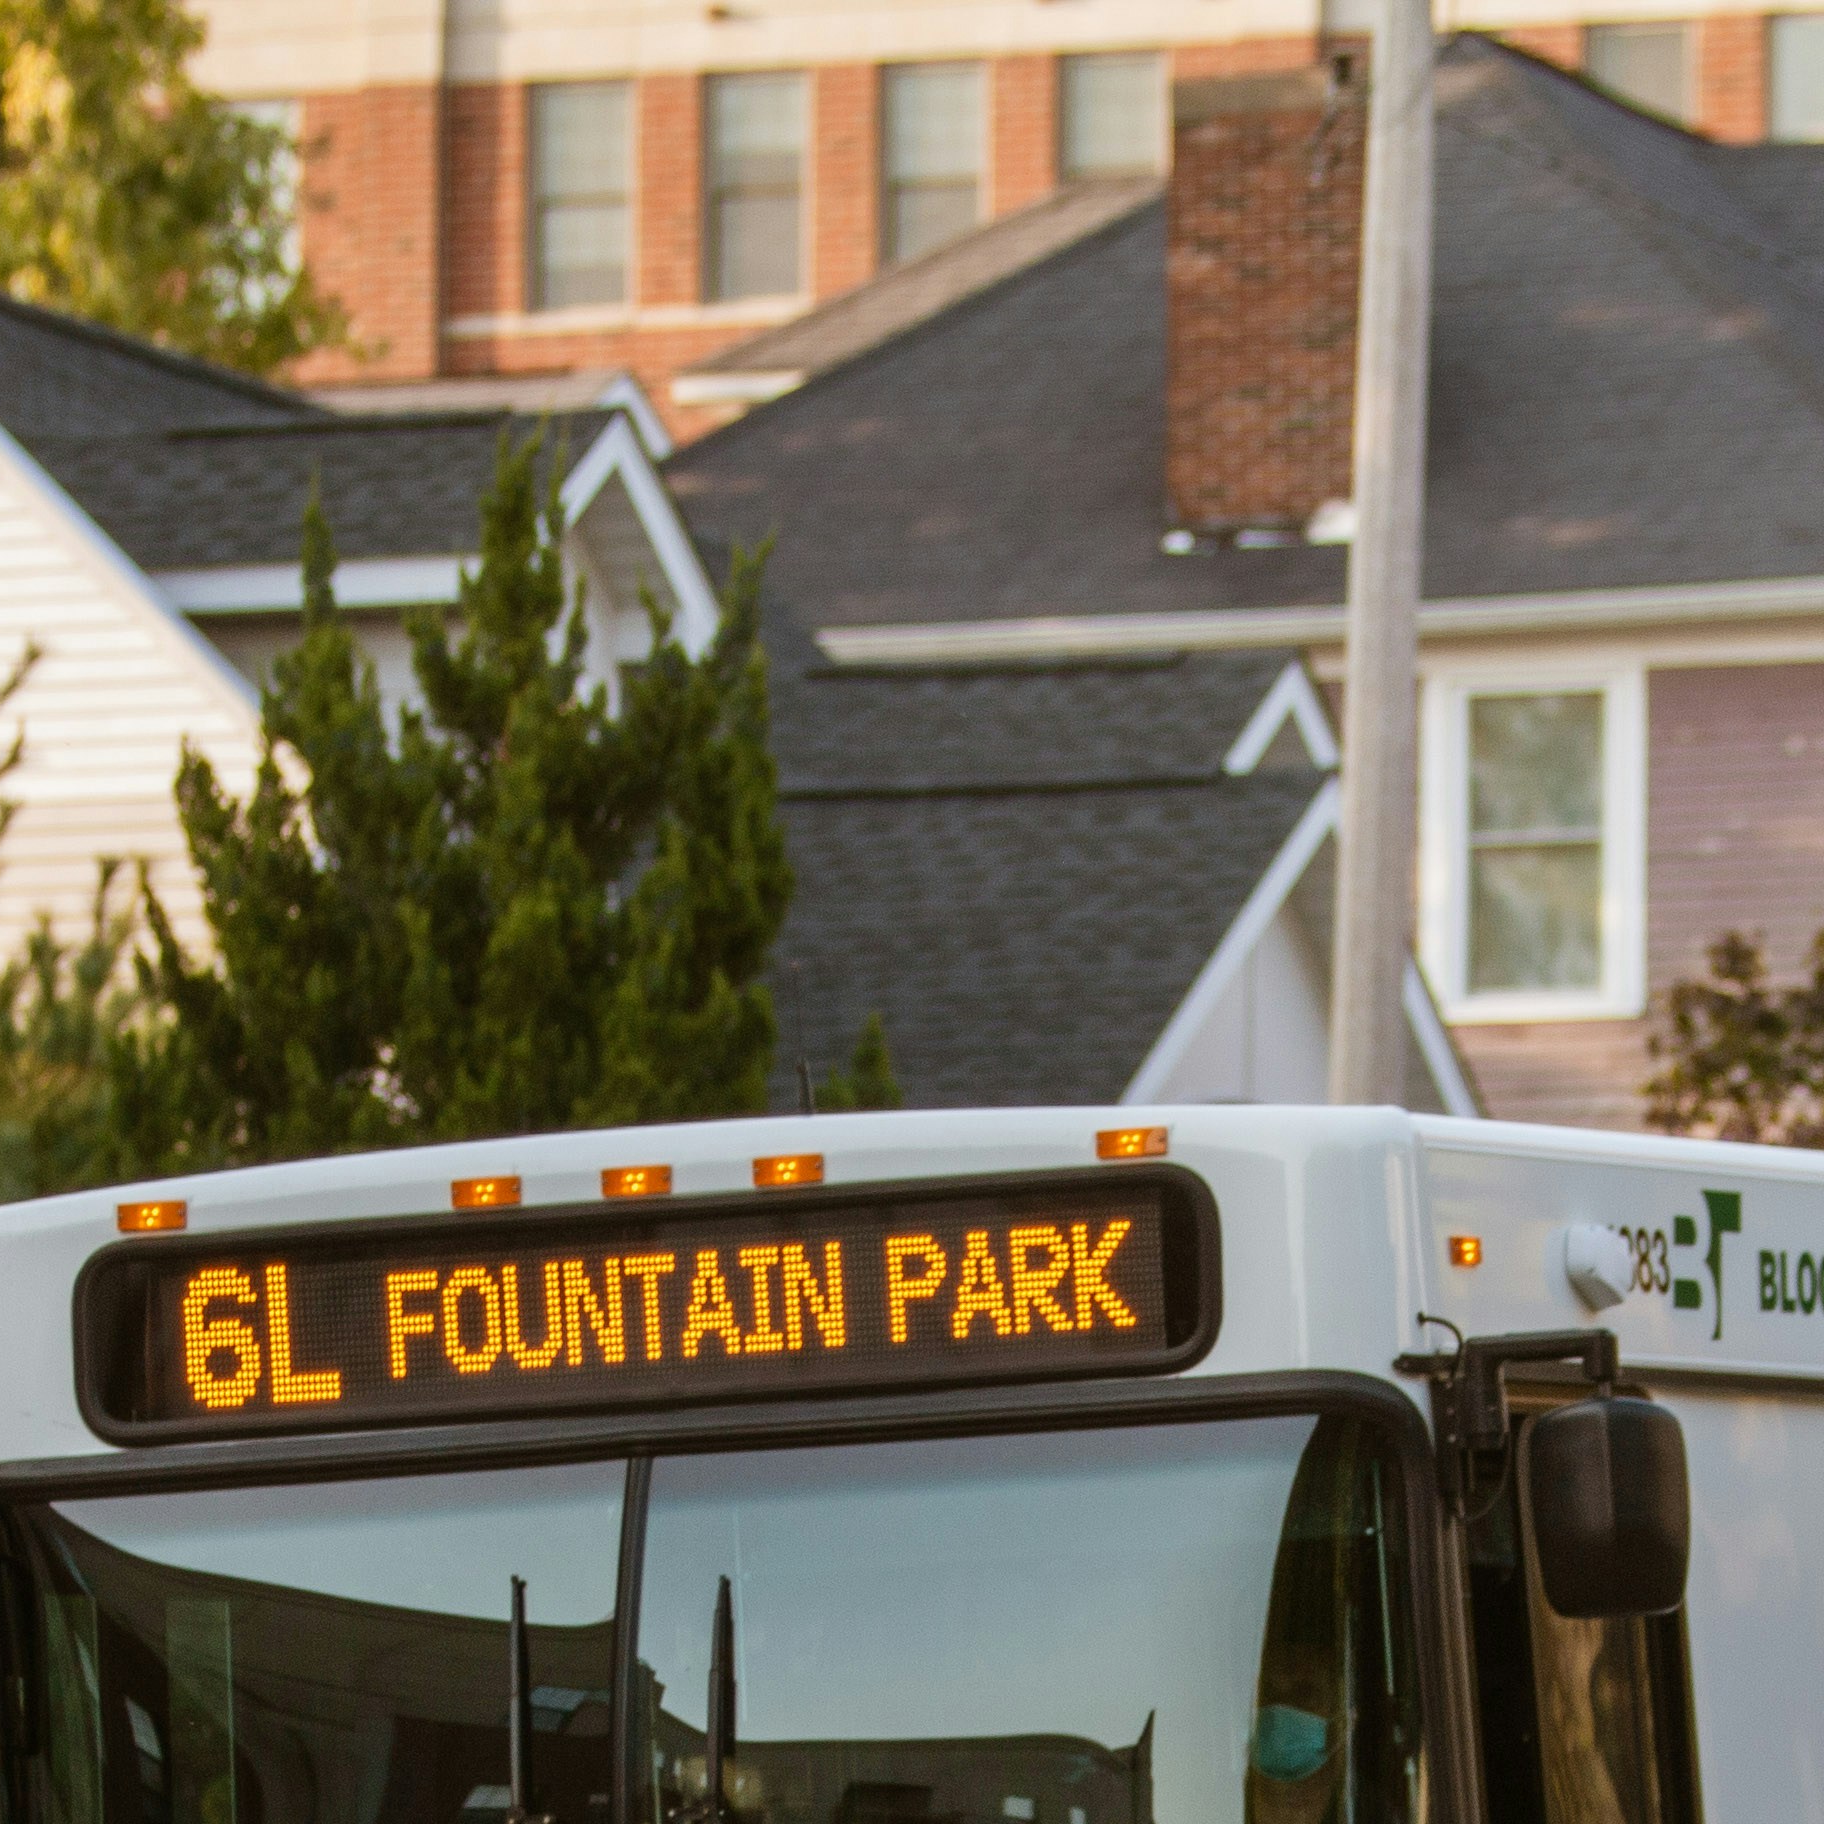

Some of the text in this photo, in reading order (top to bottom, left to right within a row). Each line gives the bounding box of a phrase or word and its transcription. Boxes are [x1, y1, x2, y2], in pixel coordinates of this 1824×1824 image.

[181, 1219, 1138, 1410] 6L FOUNTAIN PARK
